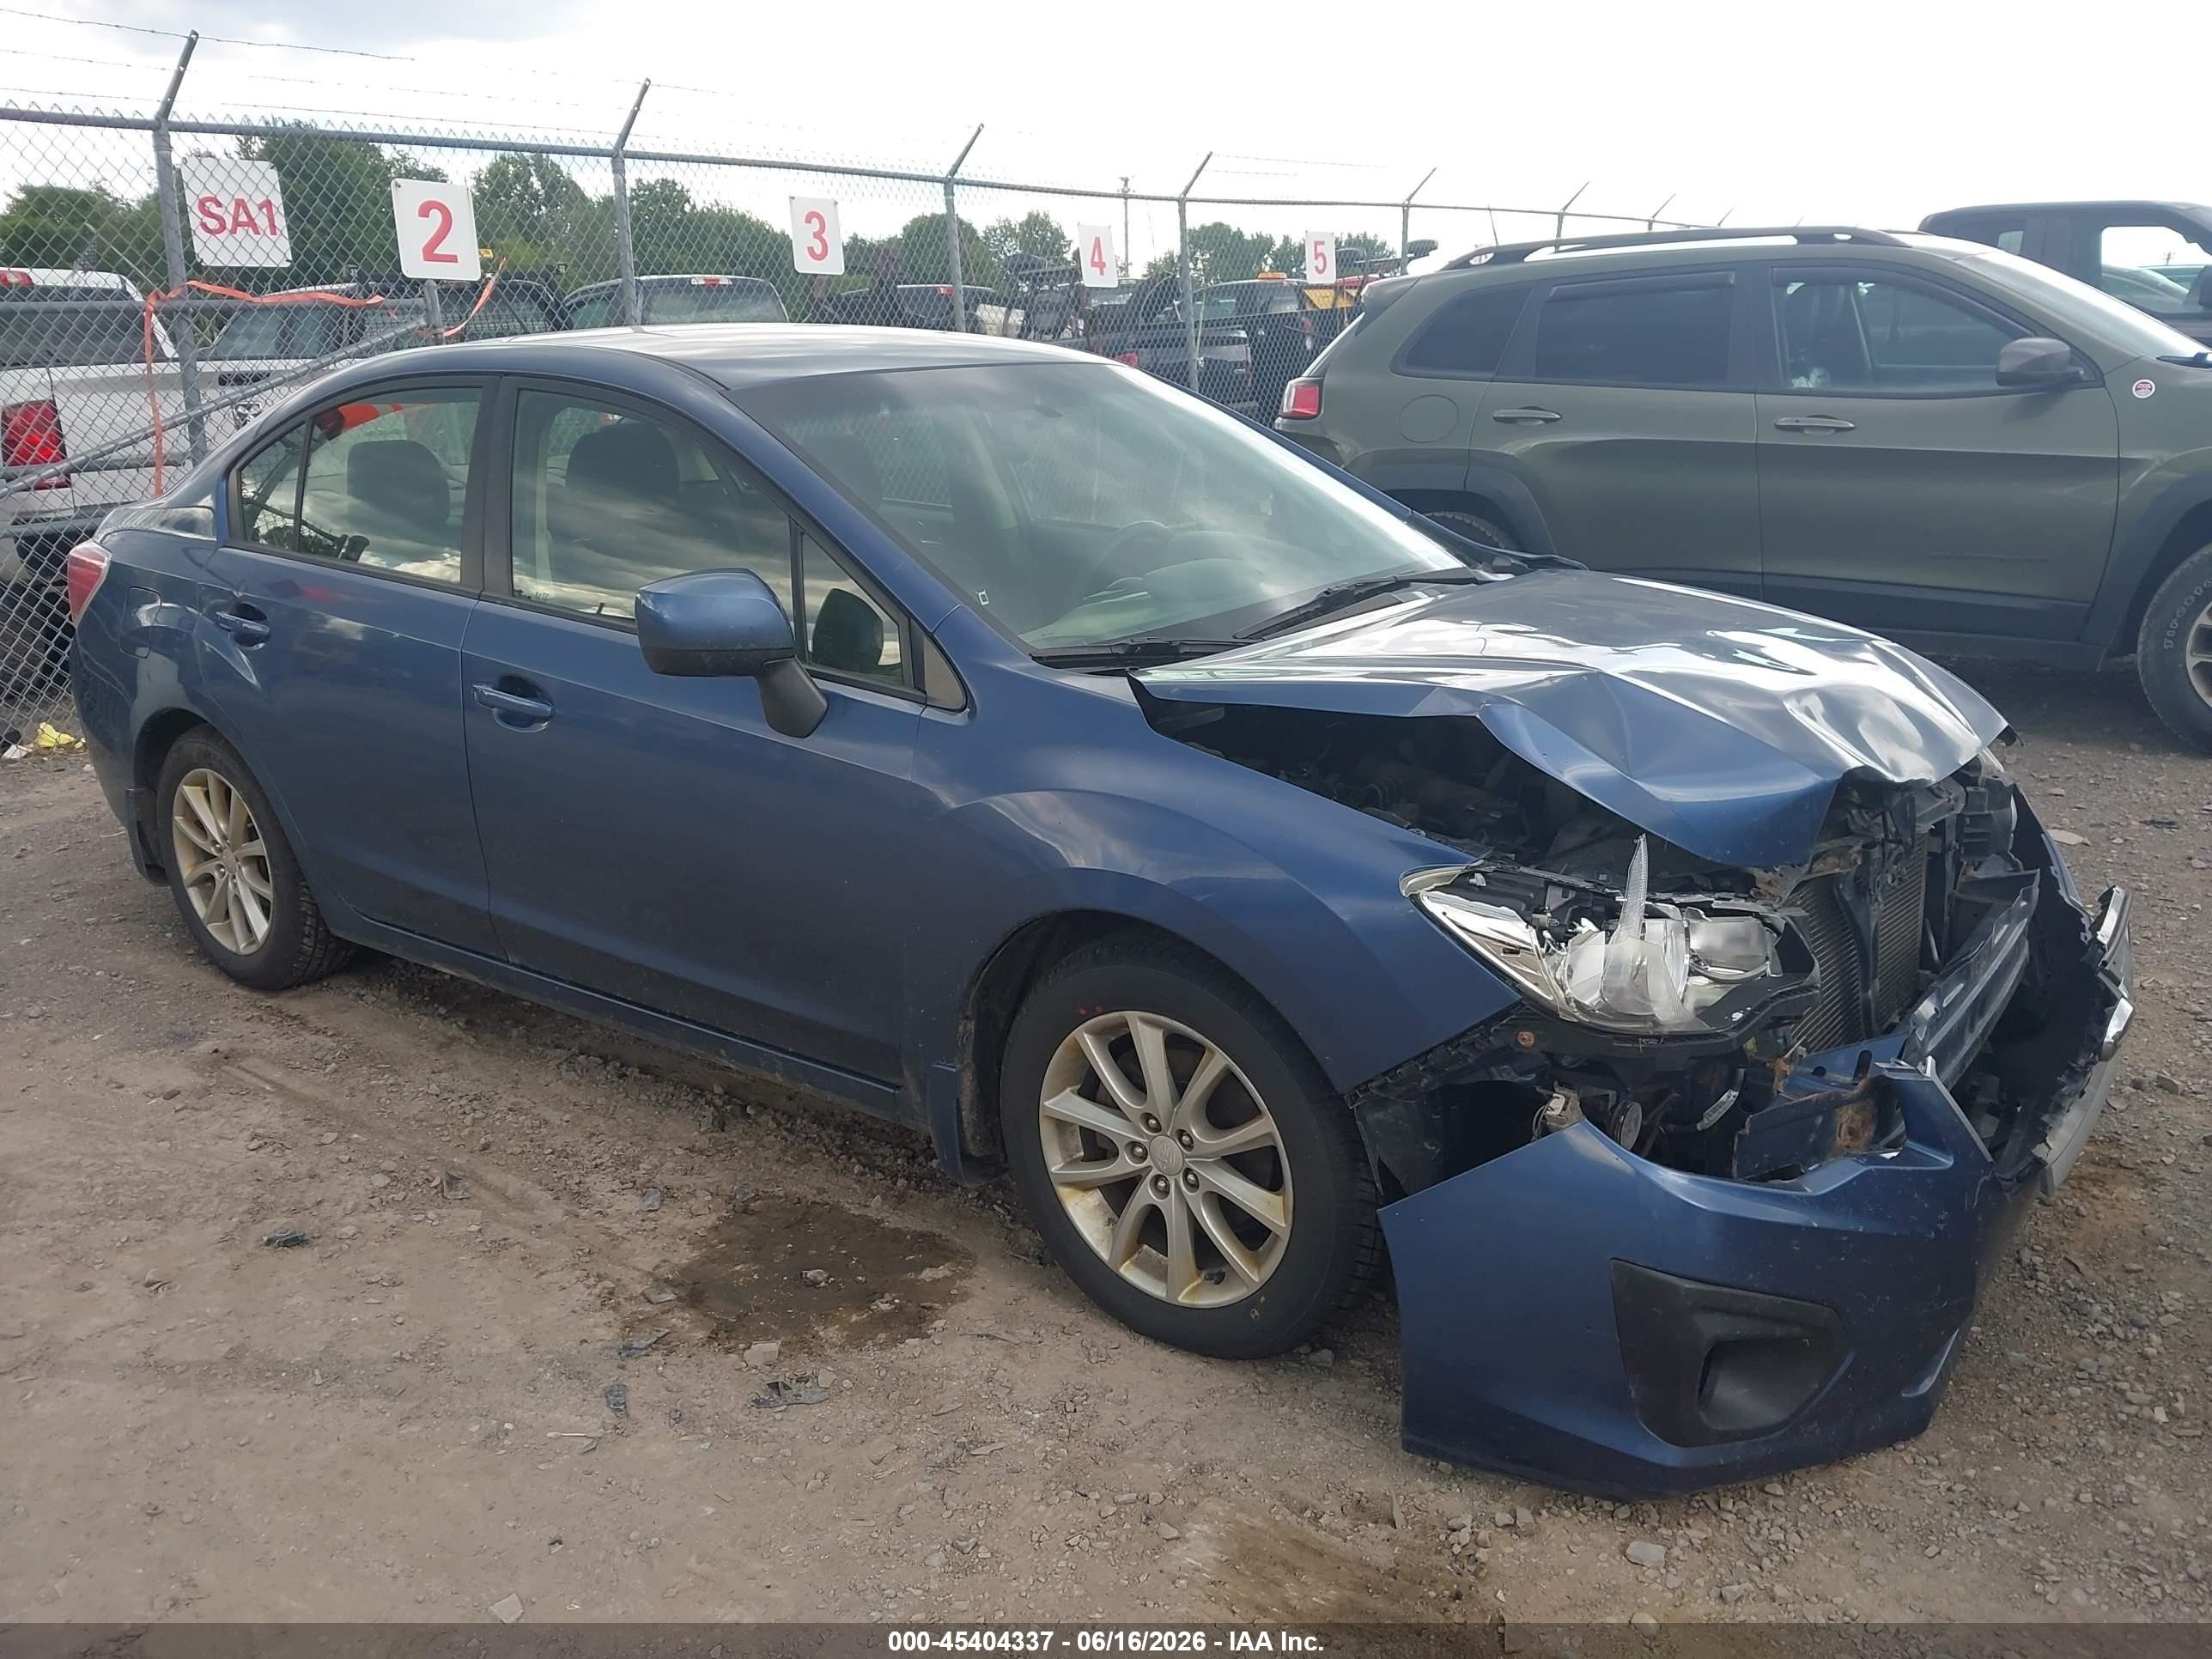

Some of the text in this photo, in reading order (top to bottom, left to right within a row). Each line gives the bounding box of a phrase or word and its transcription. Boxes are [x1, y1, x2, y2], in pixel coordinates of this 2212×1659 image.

[197, 195, 279, 236] SA1
[417, 200, 459, 264] 2
[804, 210, 830, 262] 3
[1090, 238, 1107, 274] 4
[1313, 240, 1328, 275] 5
